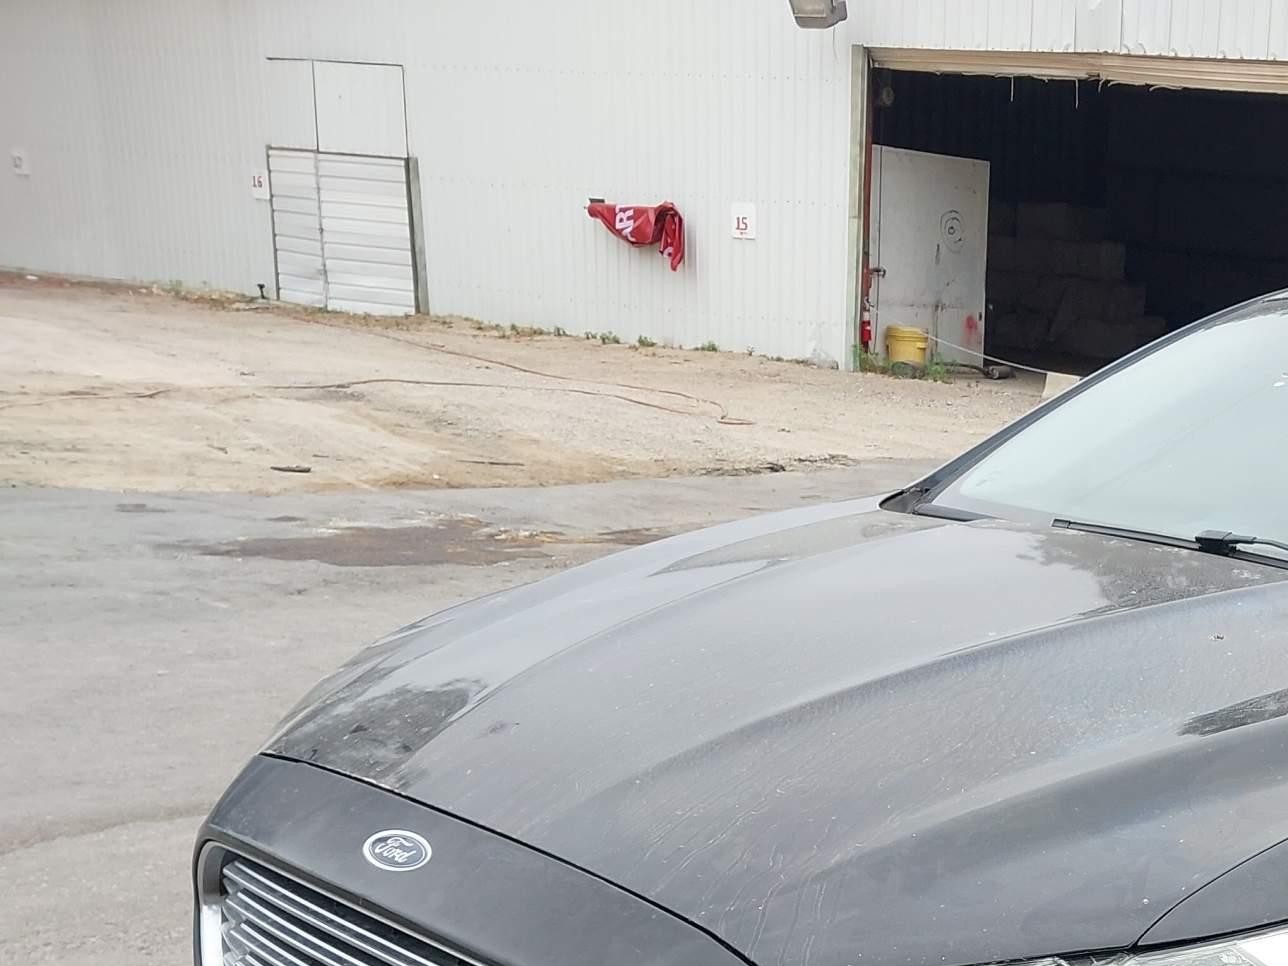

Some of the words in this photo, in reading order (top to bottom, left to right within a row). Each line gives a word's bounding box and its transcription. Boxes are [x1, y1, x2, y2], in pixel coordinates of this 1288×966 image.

[253, 175, 263, 188] 16
[735, 216, 748, 231] 15
[374, 836, 417, 863] Ford
